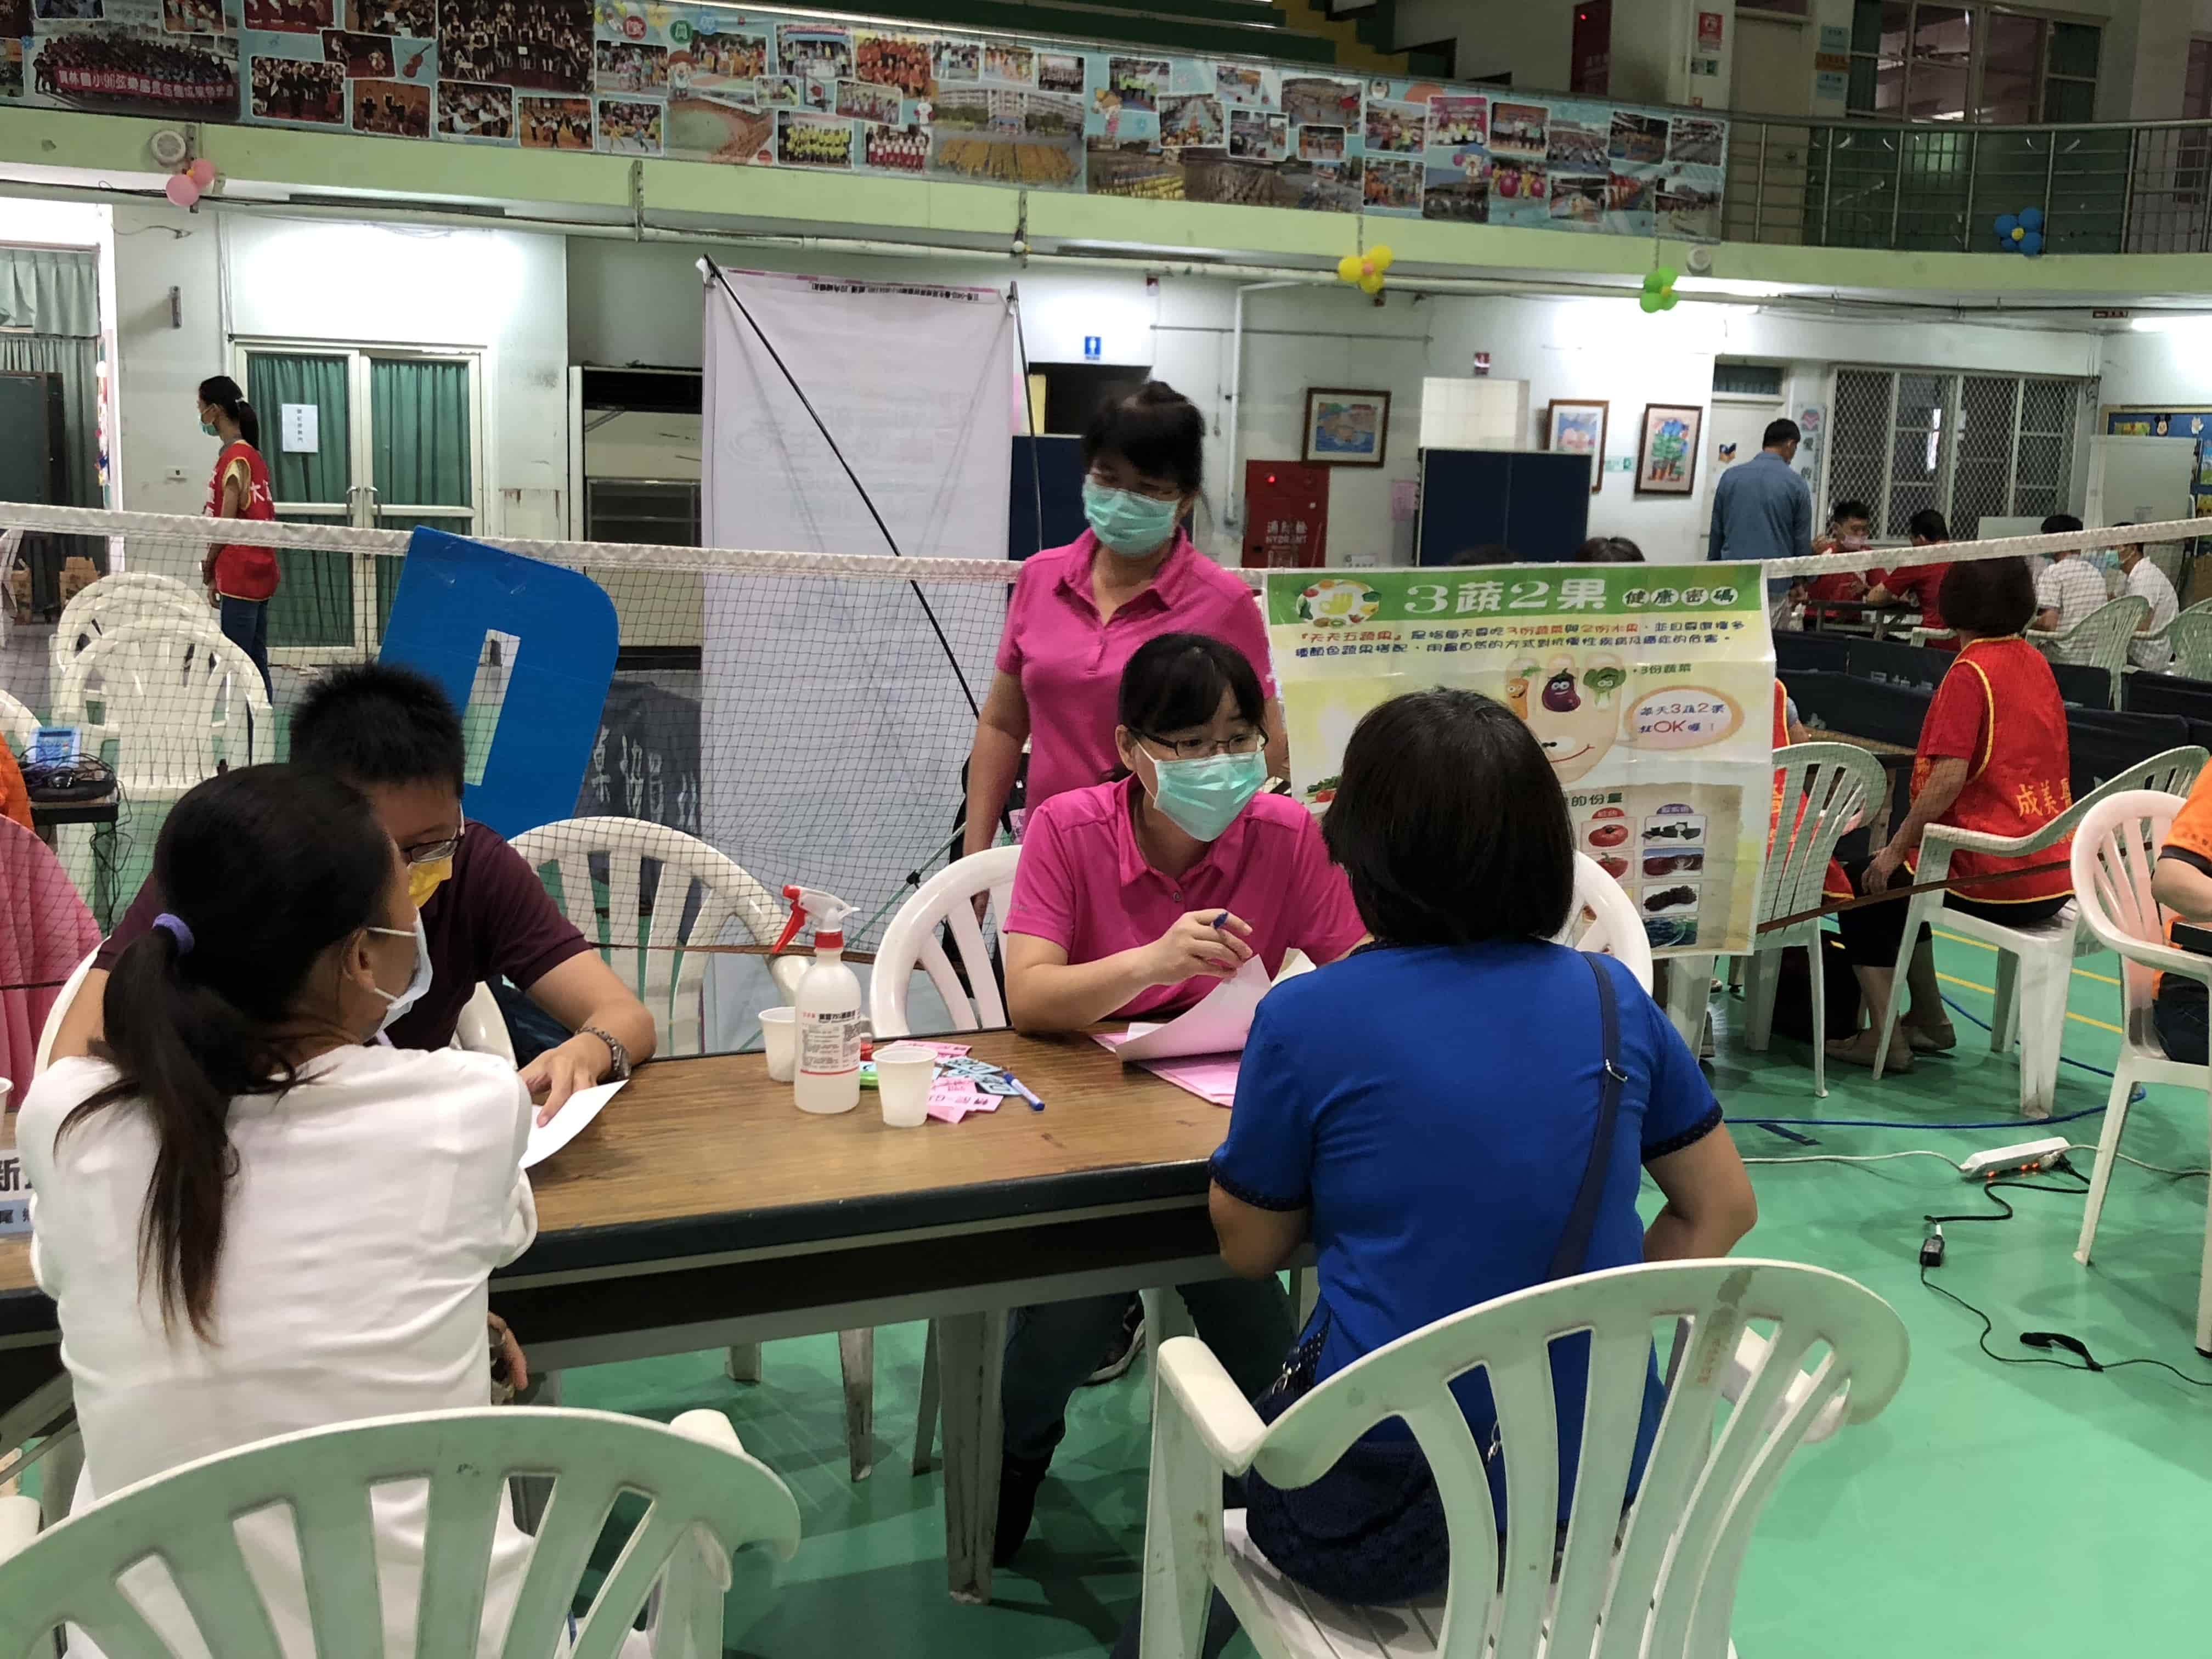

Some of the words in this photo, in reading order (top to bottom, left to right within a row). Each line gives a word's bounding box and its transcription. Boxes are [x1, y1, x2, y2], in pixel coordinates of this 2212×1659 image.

[1404, 578, 1607, 613] 3蔬2果
[1624, 587, 1735, 606] 健康密碼
[1564, 792, 1623, 807] 的份量
[0, 1157, 32, 1191] 新
